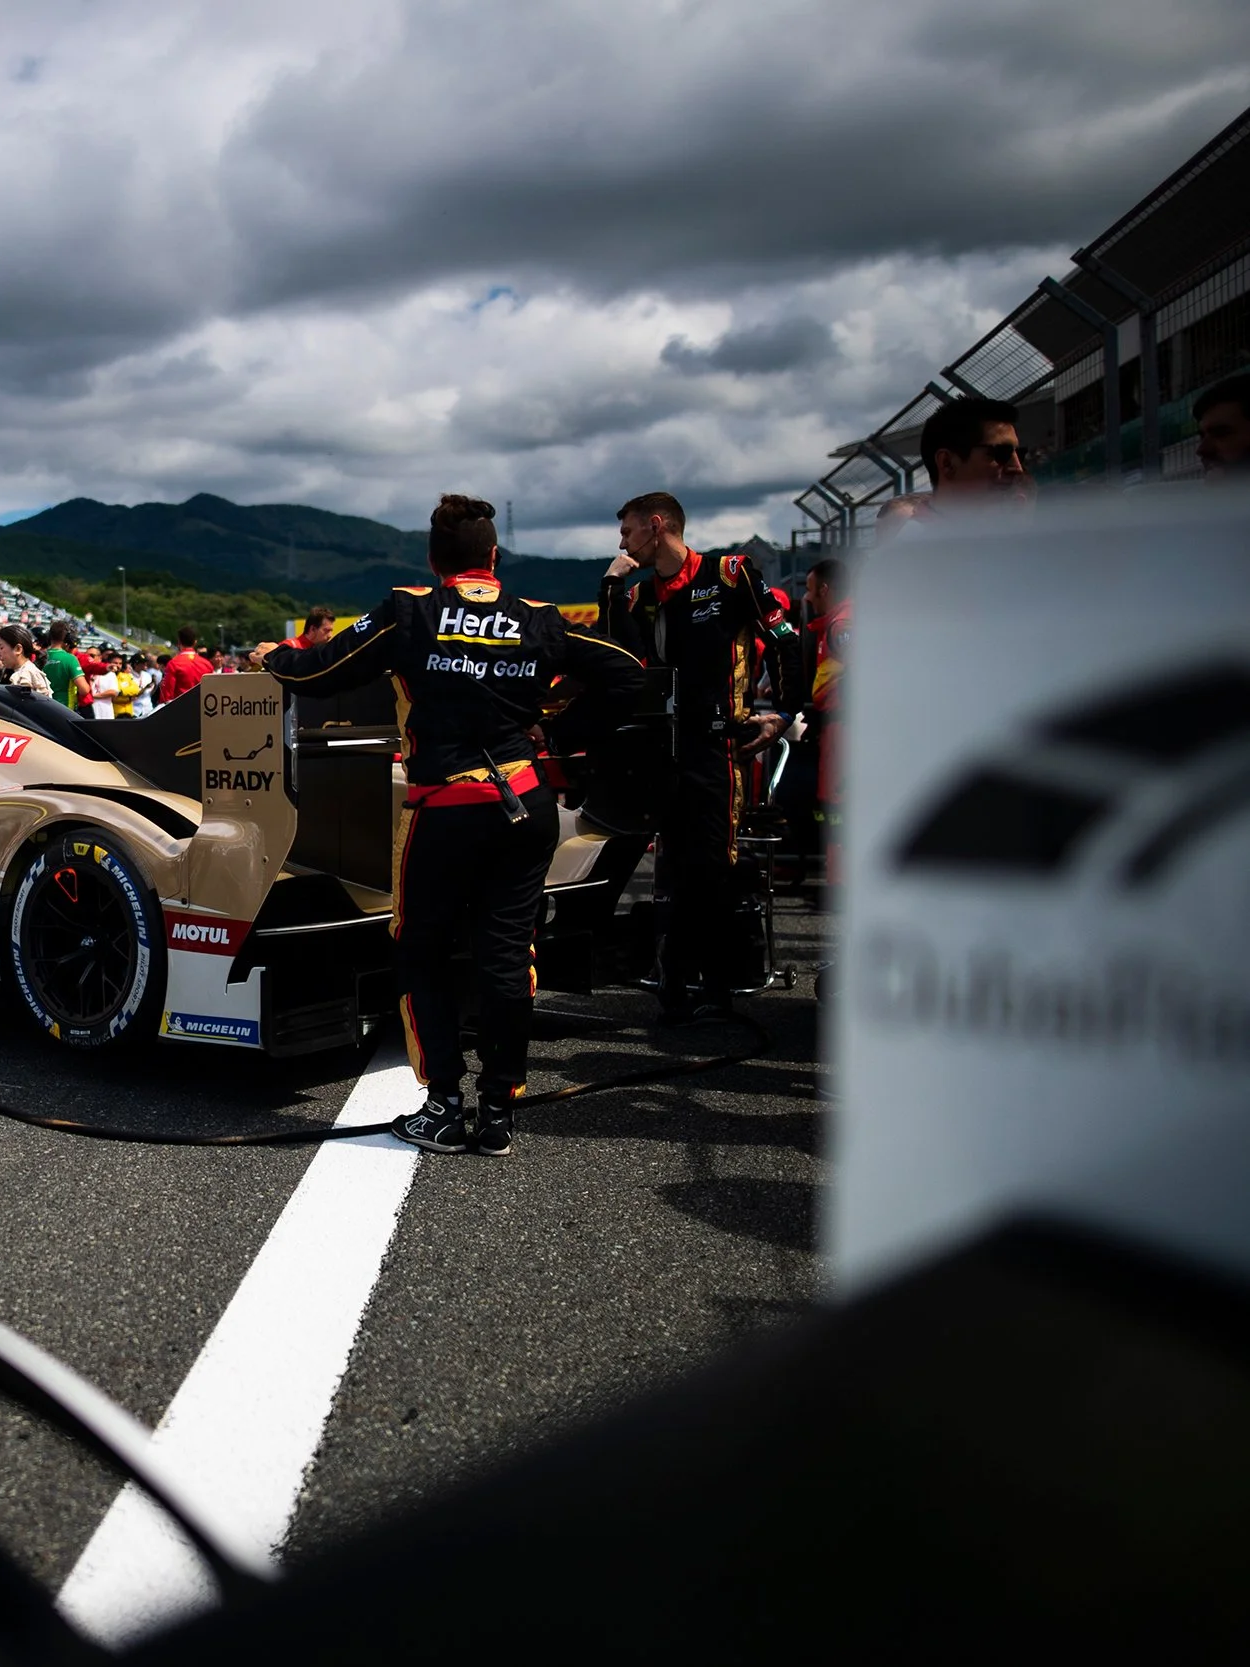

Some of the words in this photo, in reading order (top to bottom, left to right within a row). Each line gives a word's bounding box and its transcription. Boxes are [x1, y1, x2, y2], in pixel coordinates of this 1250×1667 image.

[438, 607, 521, 639] Hertz
[426, 654, 488, 680] Racing
[493, 659, 537, 678] Gold
[221, 696, 279, 716] Palantir
[205, 770, 275, 791] BRADY
[111, 866, 147, 940] MICHELIN
[172, 923, 230, 944] MOTUL
[13, 948, 44, 1020] MICHELIN
[186, 1021, 251, 1037] MICHELIN
